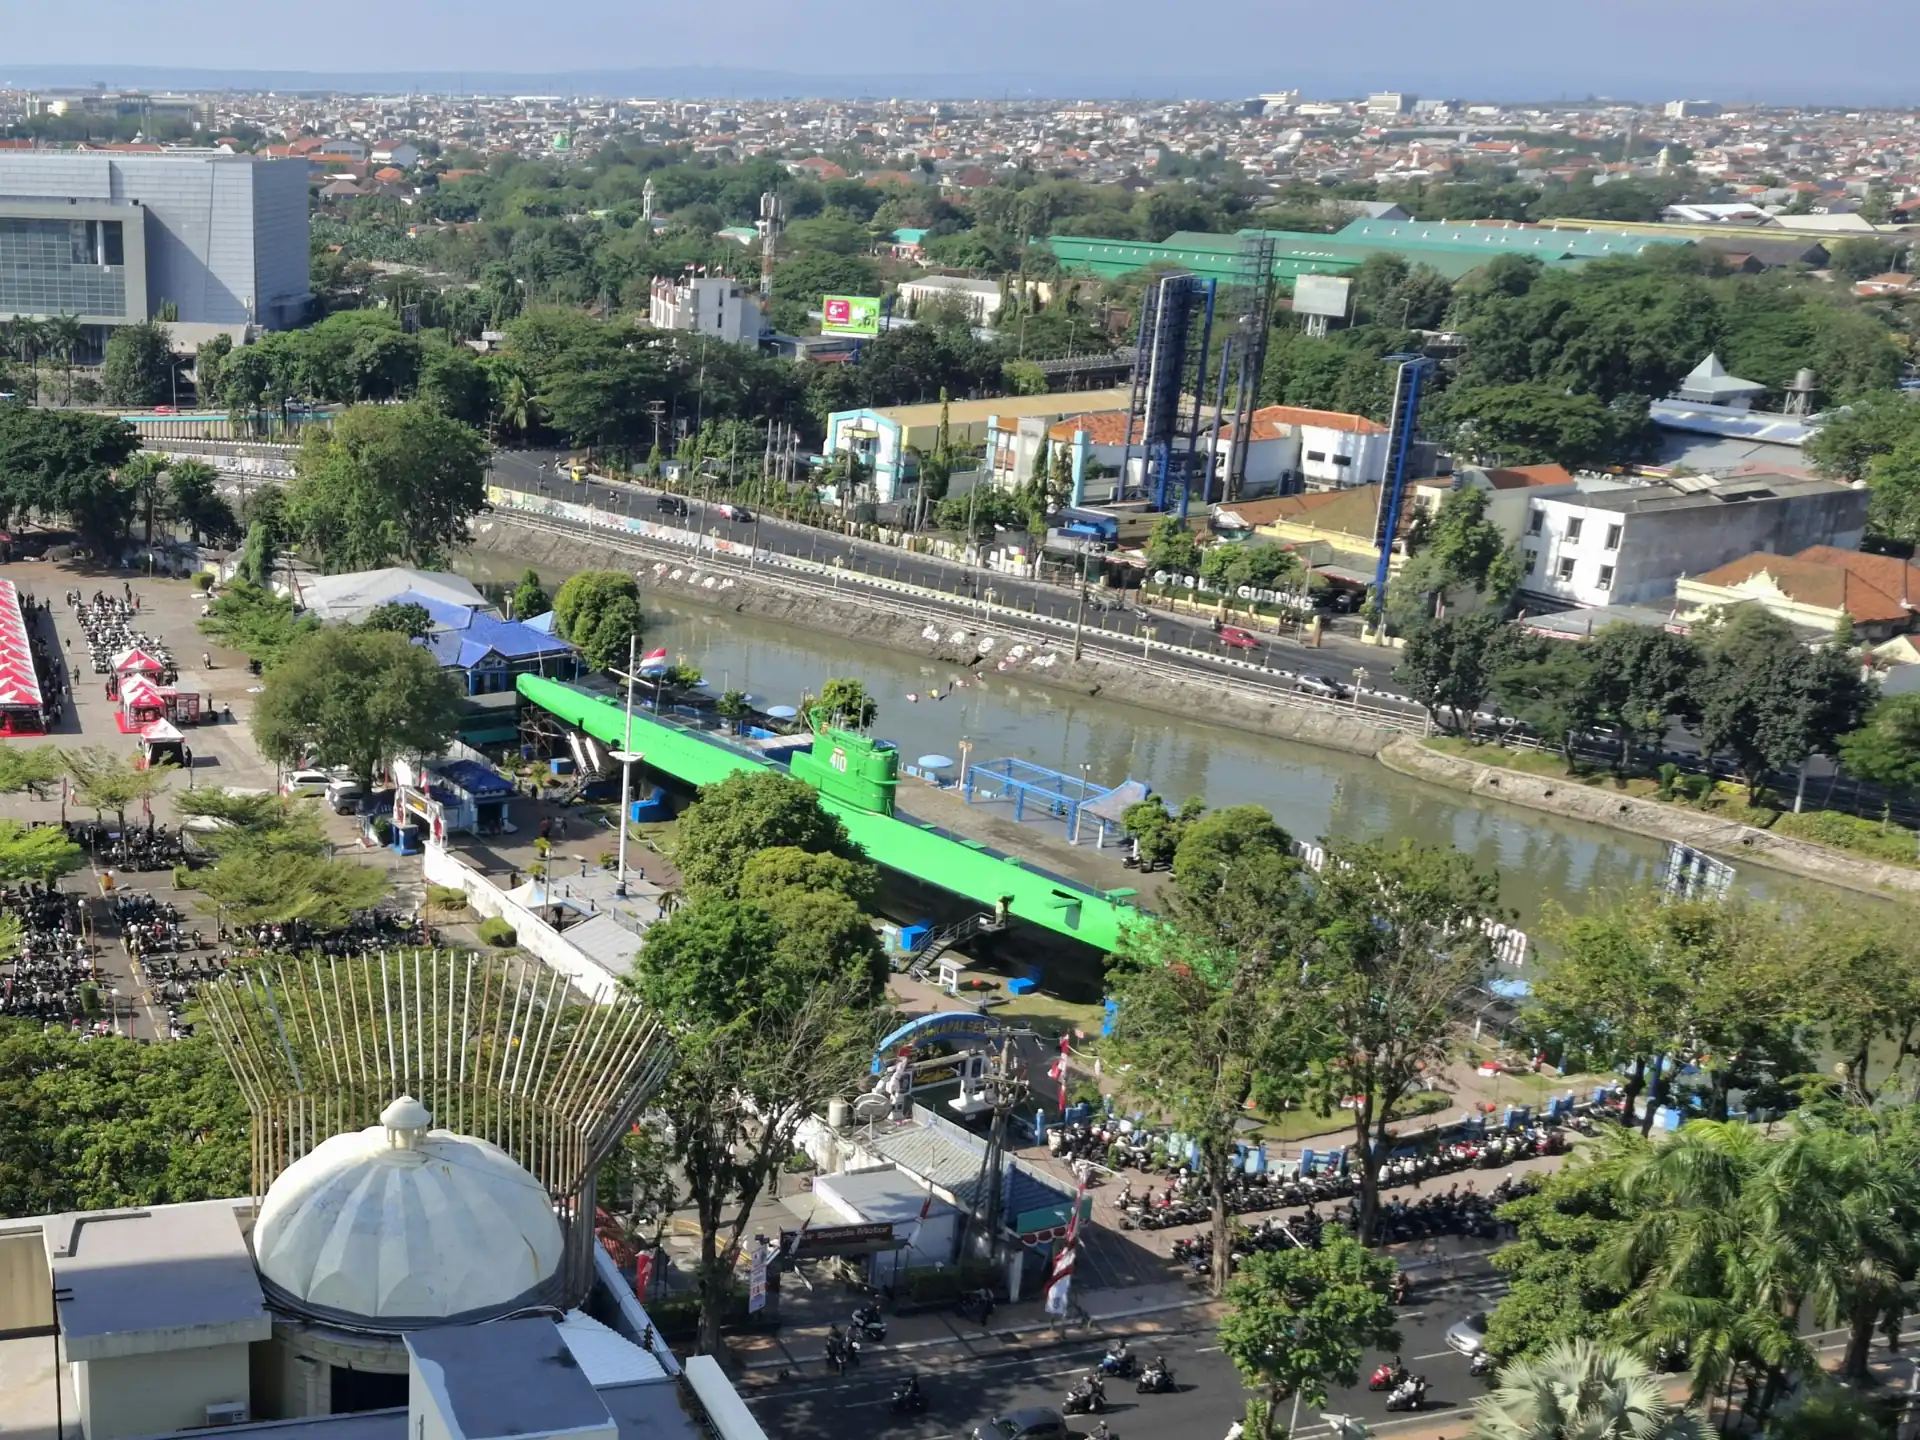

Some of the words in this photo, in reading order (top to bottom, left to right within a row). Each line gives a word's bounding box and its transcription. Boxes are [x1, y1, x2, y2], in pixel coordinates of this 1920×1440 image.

[1237, 585, 1314, 611] GUBENG
[829, 752, 847, 773] 410
[817, 1229, 855, 1241] Sepeda
[856, 1225, 891, 1236] Motor
